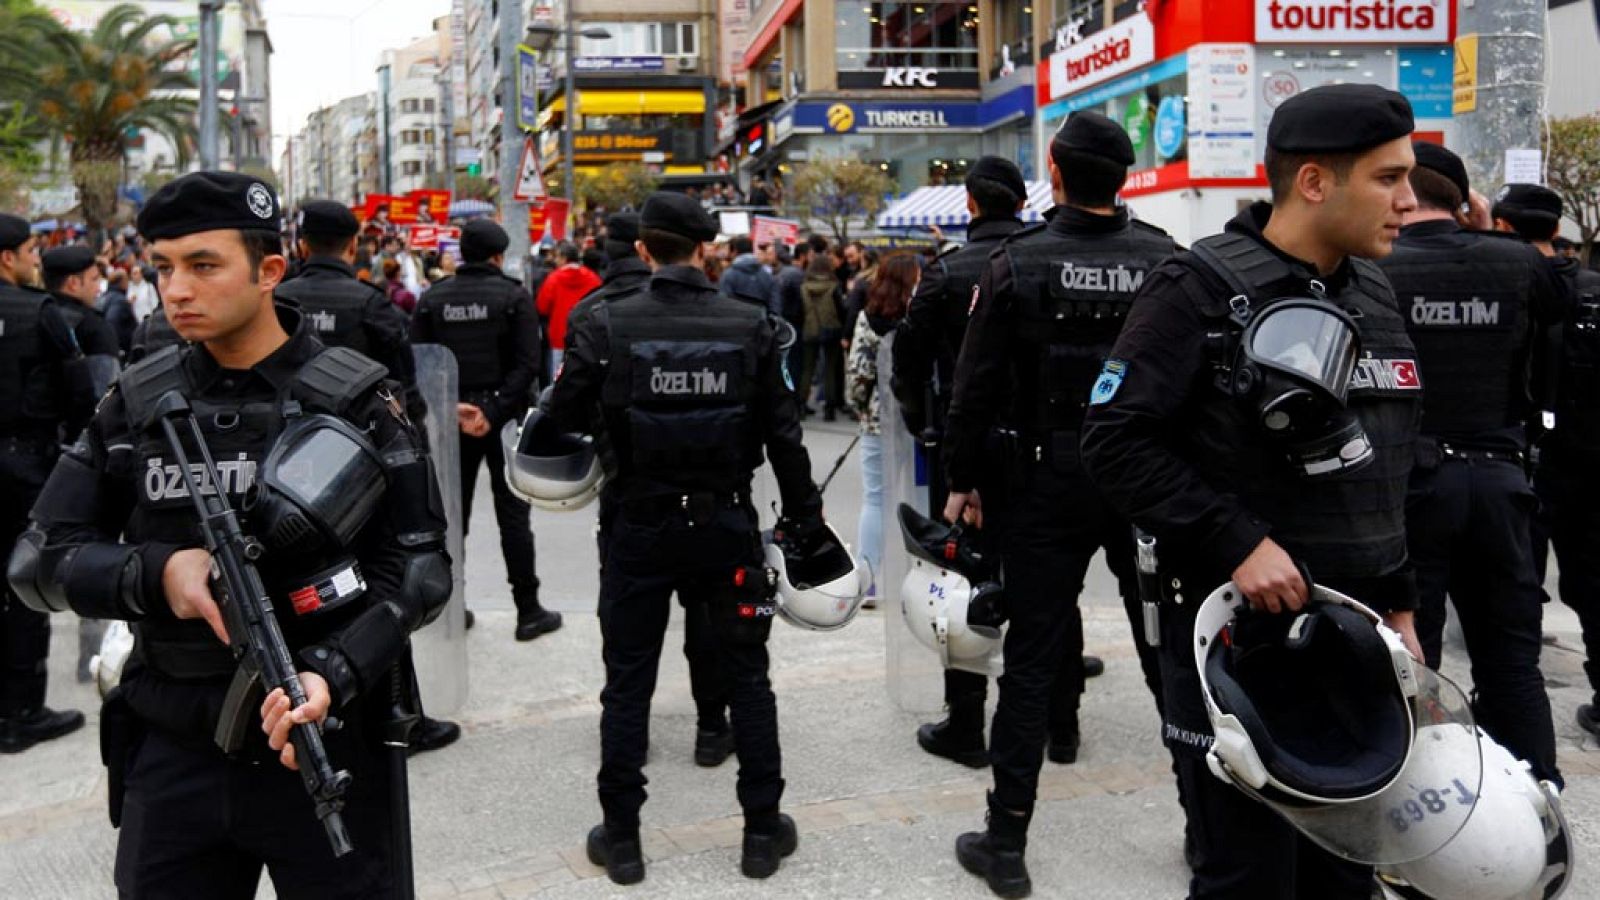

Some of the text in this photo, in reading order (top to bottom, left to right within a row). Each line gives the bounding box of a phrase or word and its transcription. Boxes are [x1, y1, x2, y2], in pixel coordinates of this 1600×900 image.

[1268, 0, 1434, 29] touristica
[1066, 36, 1131, 82] touristica
[883, 67, 937, 87] KFC
[865, 110, 948, 126] TURKCELL
